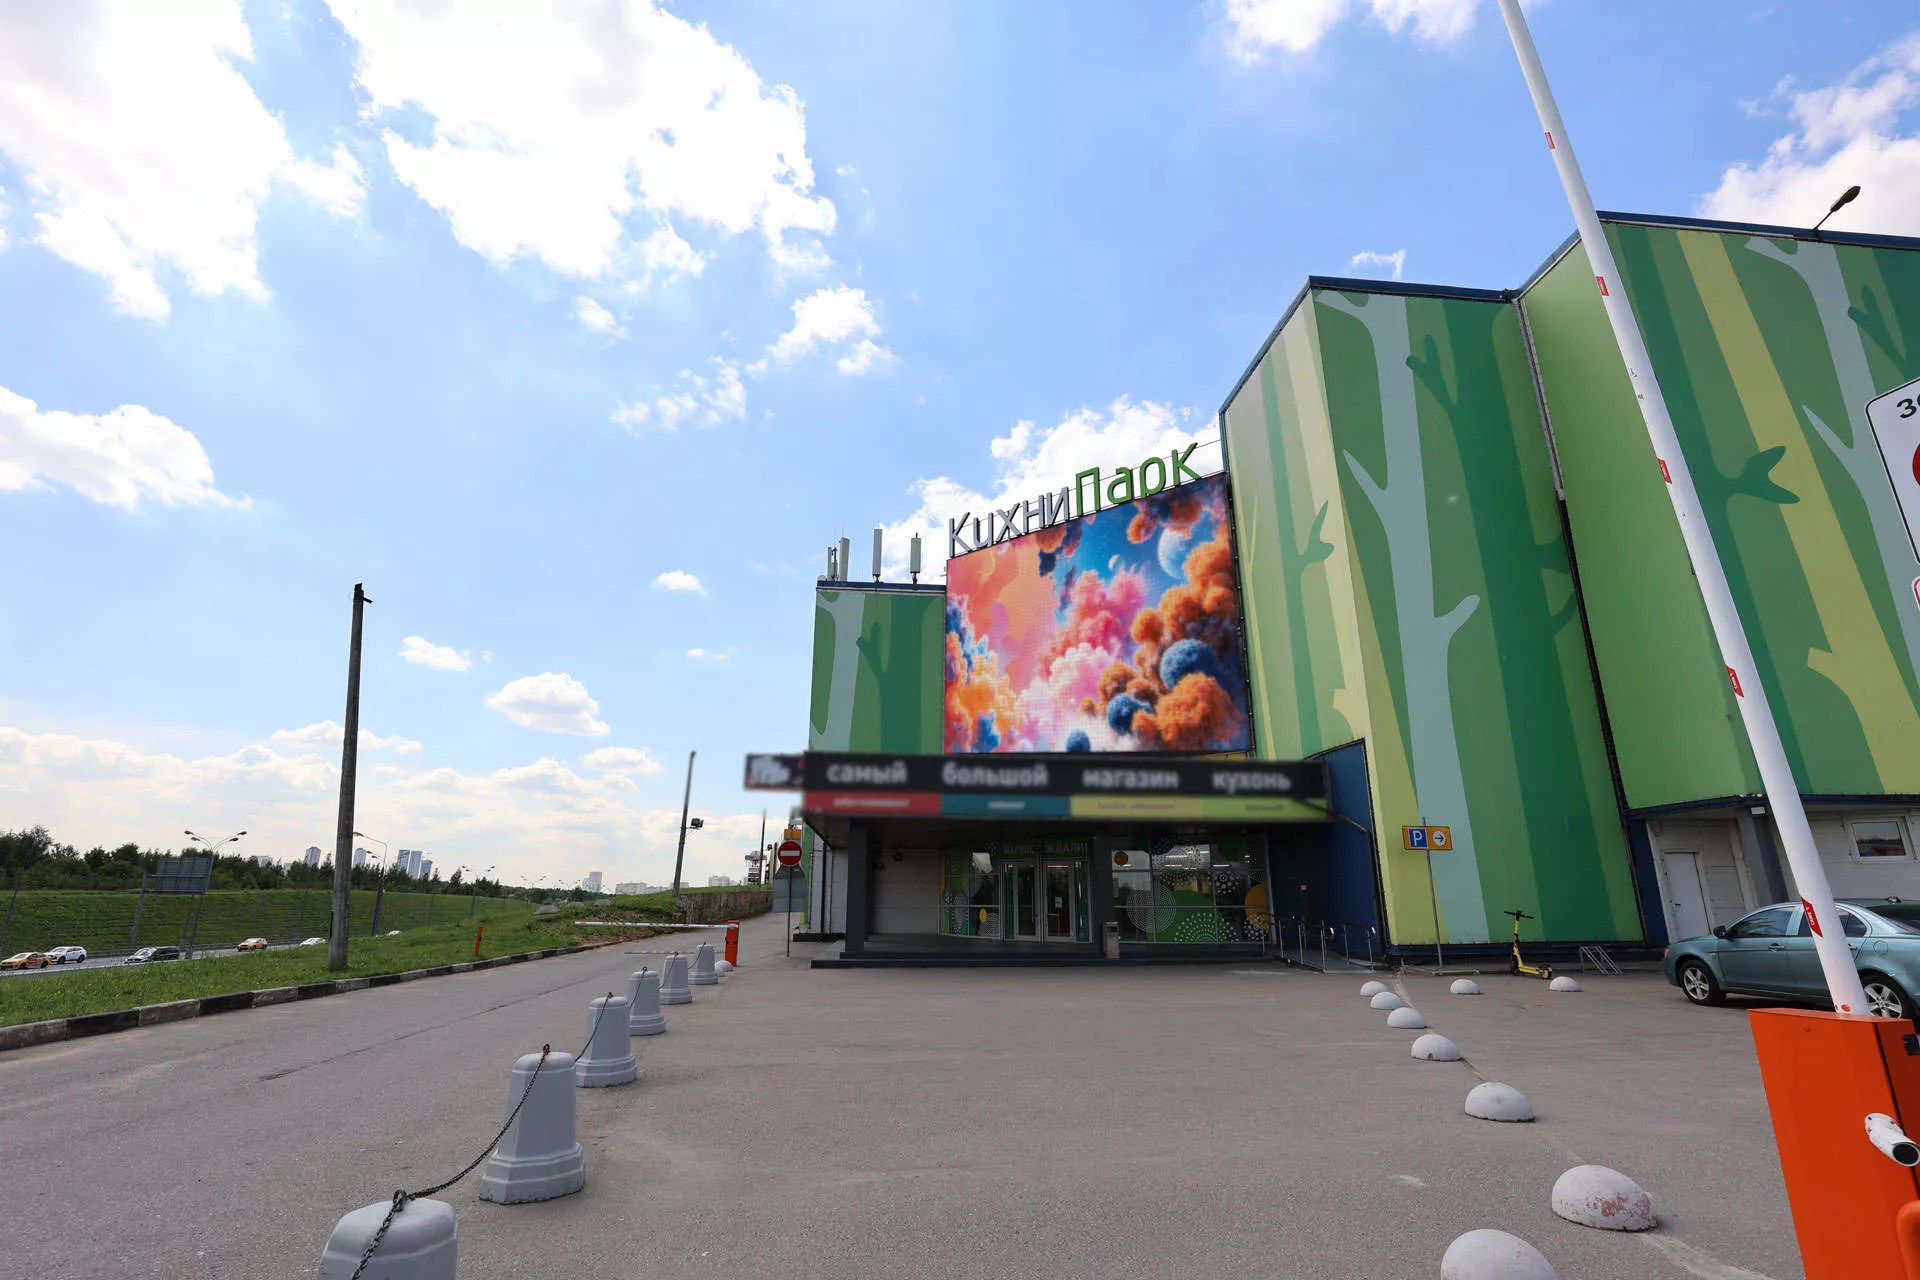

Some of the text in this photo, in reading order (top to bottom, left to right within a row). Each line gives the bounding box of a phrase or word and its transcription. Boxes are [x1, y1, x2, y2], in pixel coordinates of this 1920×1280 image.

[826, 759, 1292, 794] самый большой магазин кухонь
